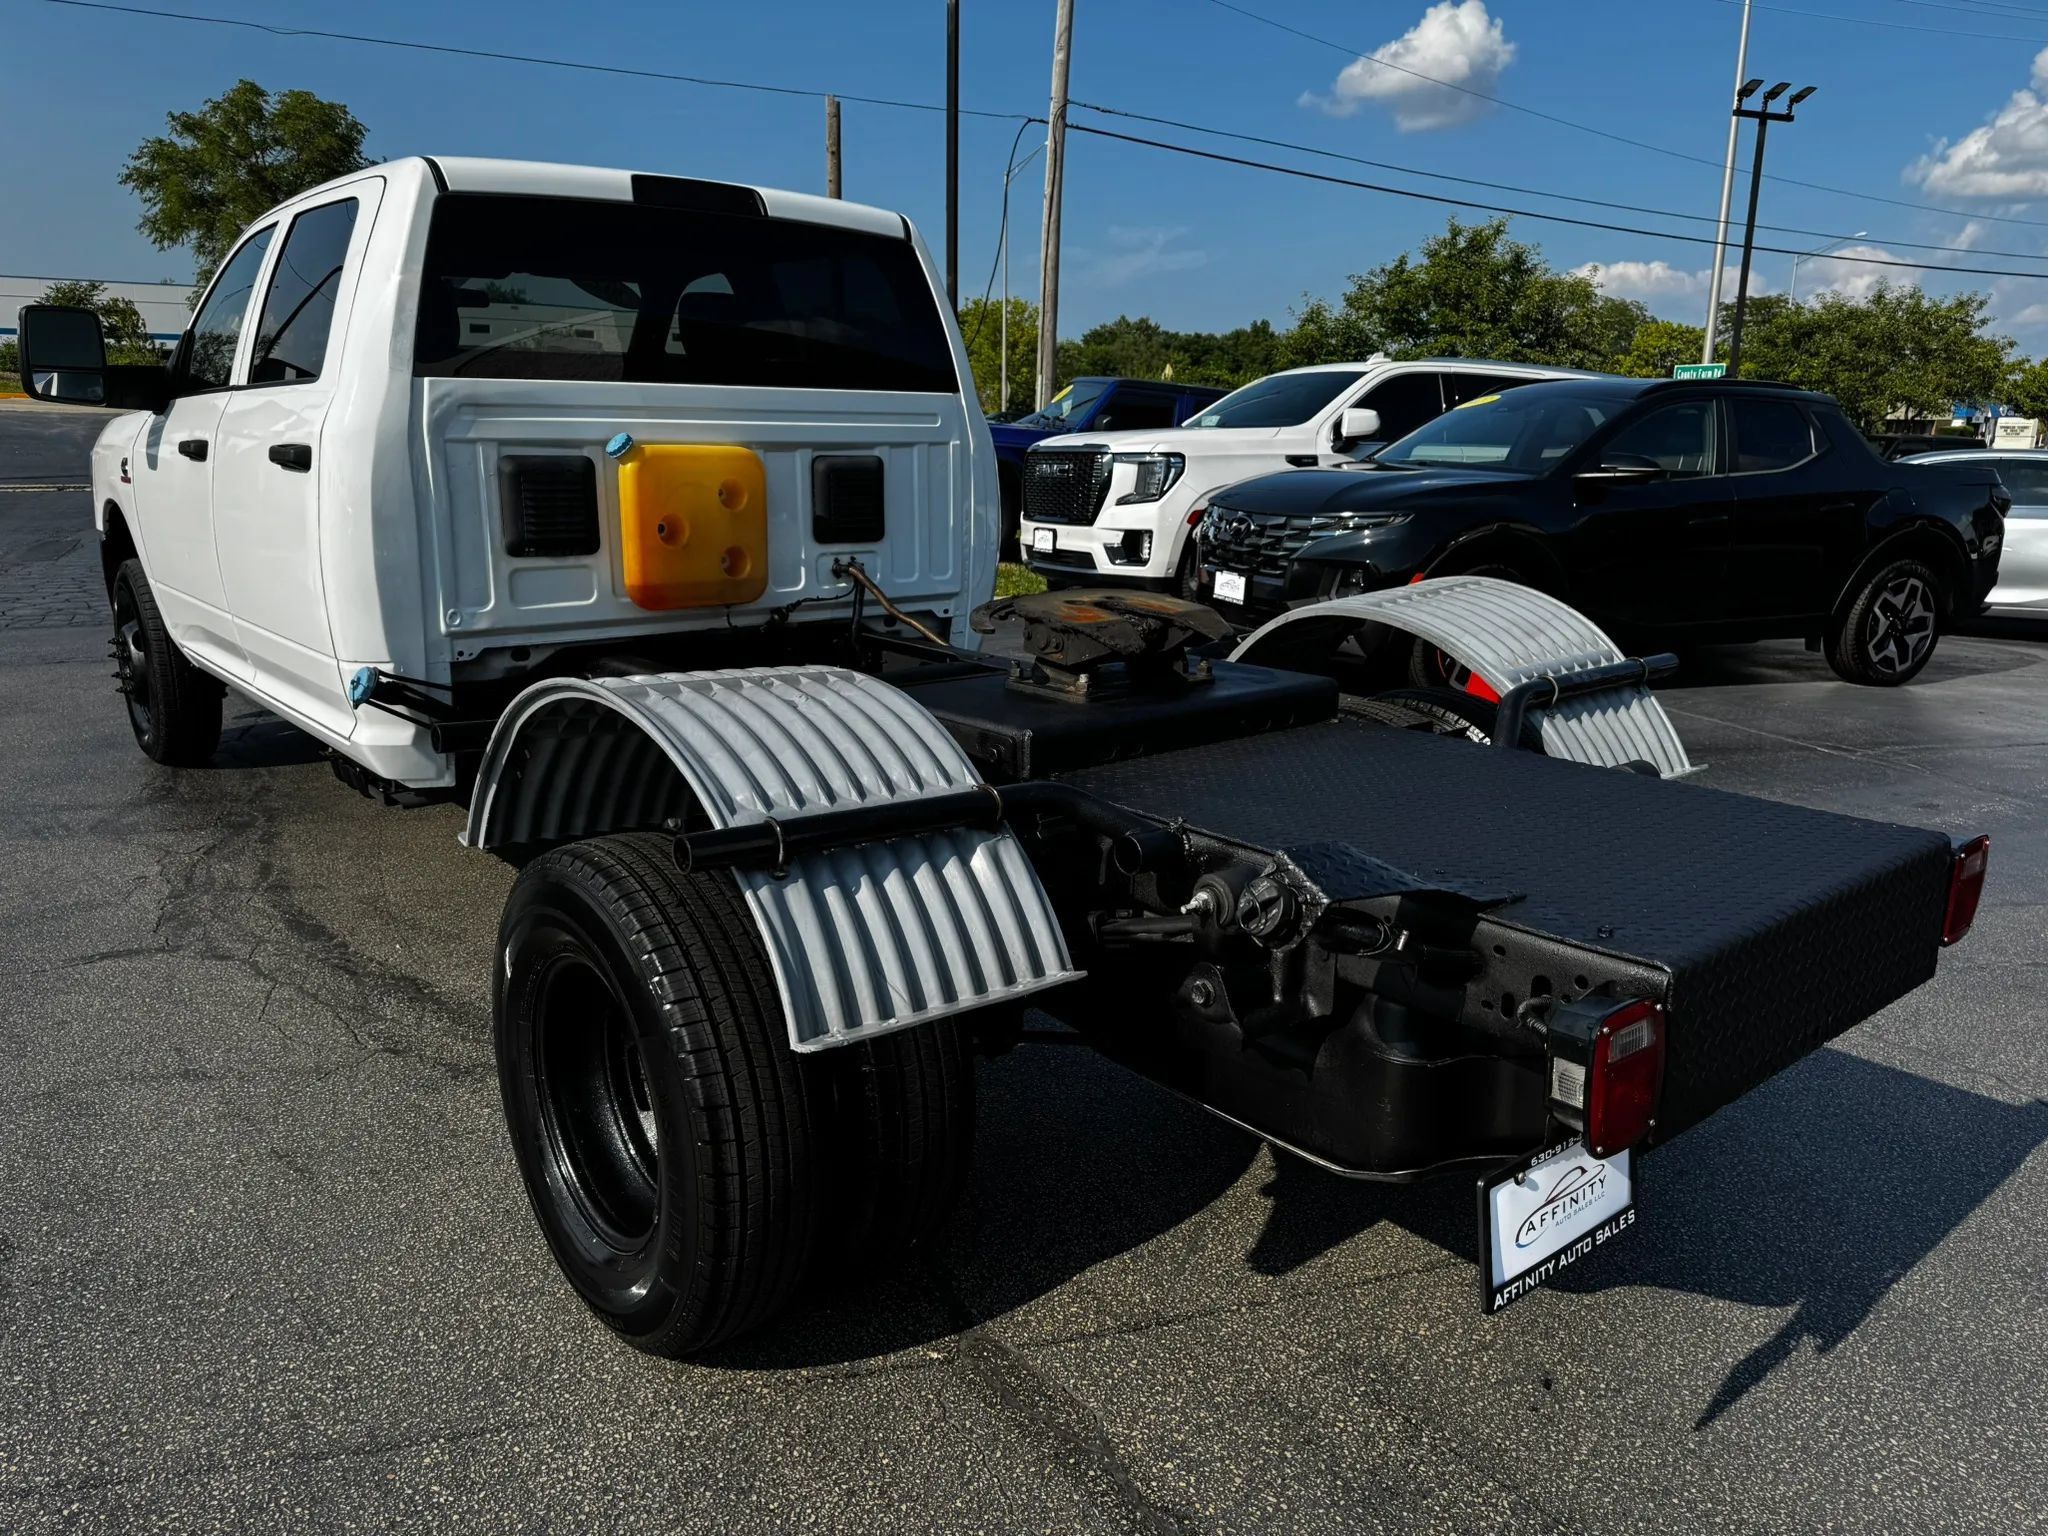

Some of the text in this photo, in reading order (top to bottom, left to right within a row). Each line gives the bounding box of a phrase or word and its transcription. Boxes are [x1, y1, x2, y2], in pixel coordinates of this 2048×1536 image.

[1677, 368, 1722, 379] County Farm Rd
[1525, 1175, 1606, 1236] AFFINITY
[1555, 1213, 1571, 1227] AUTO
[1573, 1199, 1592, 1216] SALES
[1493, 1209, 1635, 1311] AFFINITY AUTO SALES
